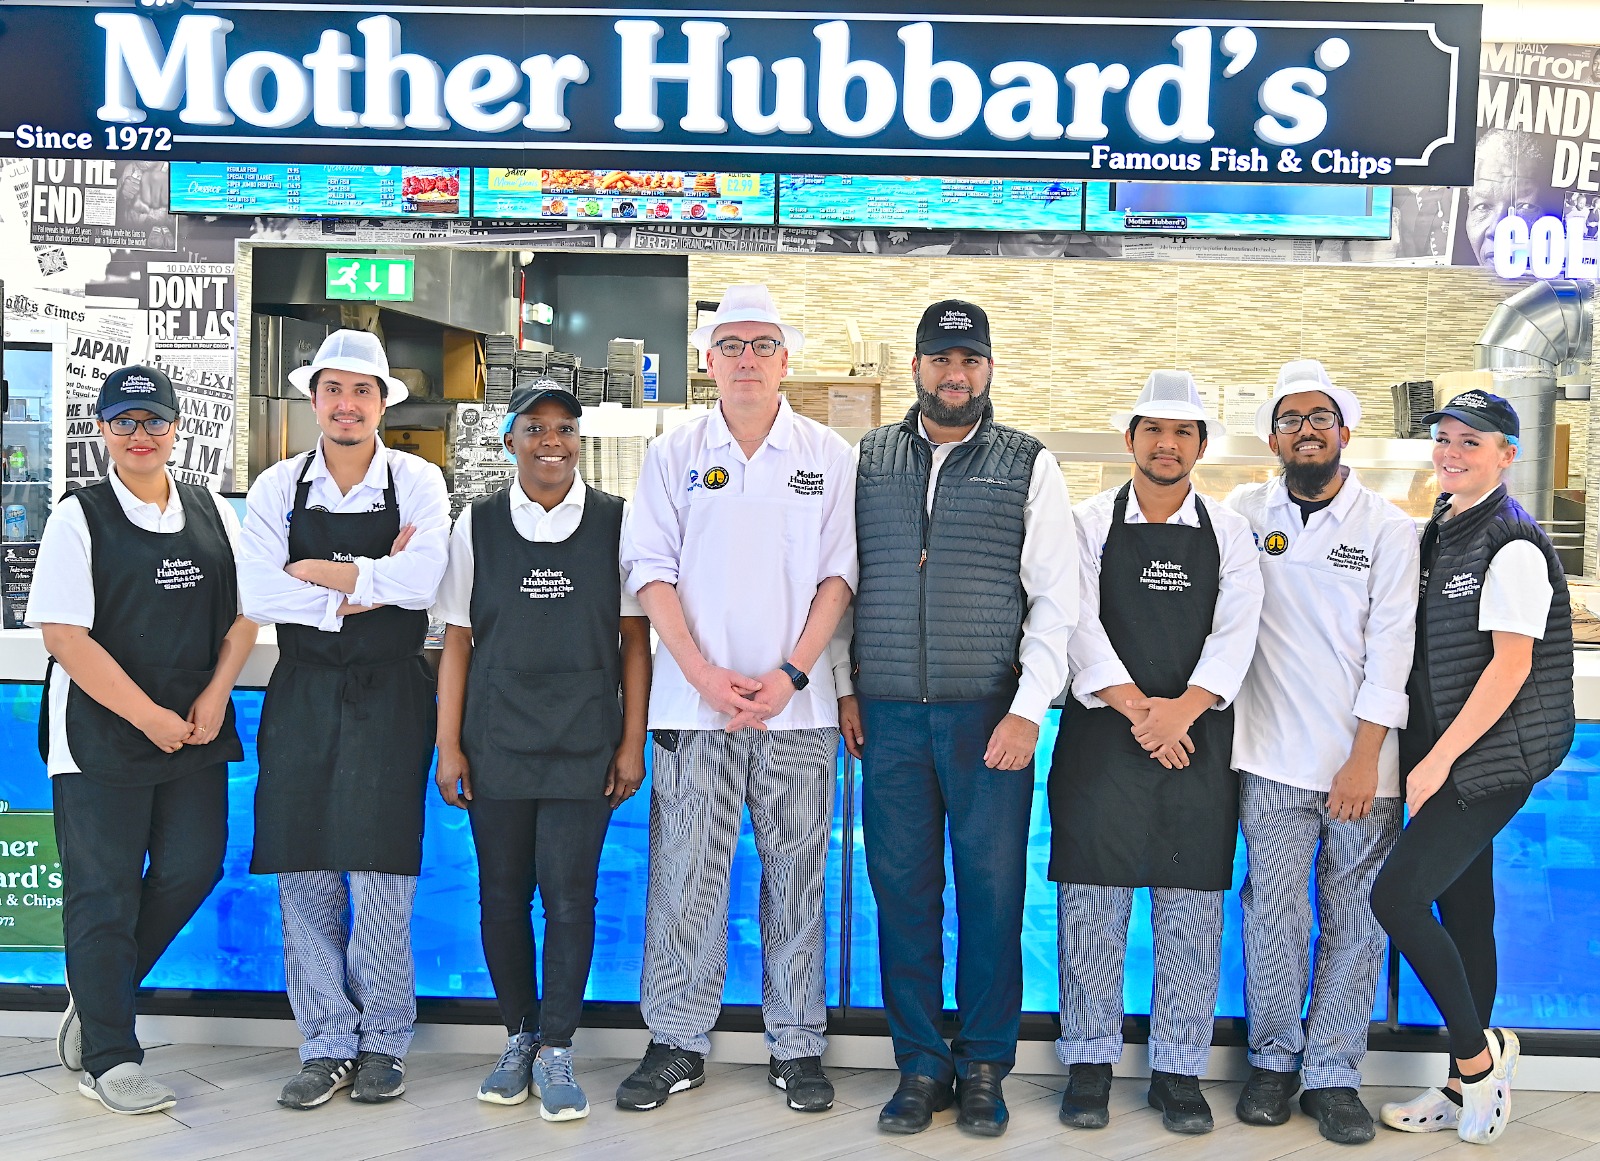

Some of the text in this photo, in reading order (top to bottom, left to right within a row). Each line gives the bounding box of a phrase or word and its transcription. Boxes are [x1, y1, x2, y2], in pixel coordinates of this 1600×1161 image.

[1516, 43, 1548, 55] DAILY
[1480, 42, 1590, 80] Mirror
[95, 12, 1351, 145] Mother Hubbard's
[15, 125, 172, 151] Since 1972
[1091, 145, 1392, 179] Famous Fish & Chips
[727, 179, 753, 192] £2.99
[33, 185, 82, 225] END
[1152, 218, 1185, 226] Hubbard's
[32, 233, 44, 242] longer
[636, 233, 678, 249] FREE
[682, 237, 704, 249] GRAND
[167, 264, 222, 274] 10 DAYS TO
[149, 275, 229, 310] DON'T
[44, 303, 85, 322] Times
[71, 337, 129, 366] JAPAN
[213, 404, 231, 421] TO
[67, 422, 94, 435] AND
[796, 469, 823, 478] Mother
[1339, 543, 1364, 554] Mother
[1330, 548, 1369, 563] Hubbard's
[163, 559, 192, 568] Mother
[1150, 560, 1182, 571] Mother
[156, 566, 201, 577] Hubbard's
[530, 569, 563, 577] Mother
[1142, 568, 1188, 580] Hubbard's
[1452, 572, 1473, 582] Mother
[522, 577, 571, 586] Hubbard's
[1140, 576, 1160, 584] Famous
[1445, 577, 1478, 589] Hubbard's
[1148, 583, 1168, 591] Since
[6, 893, 63, 908] & Chips
